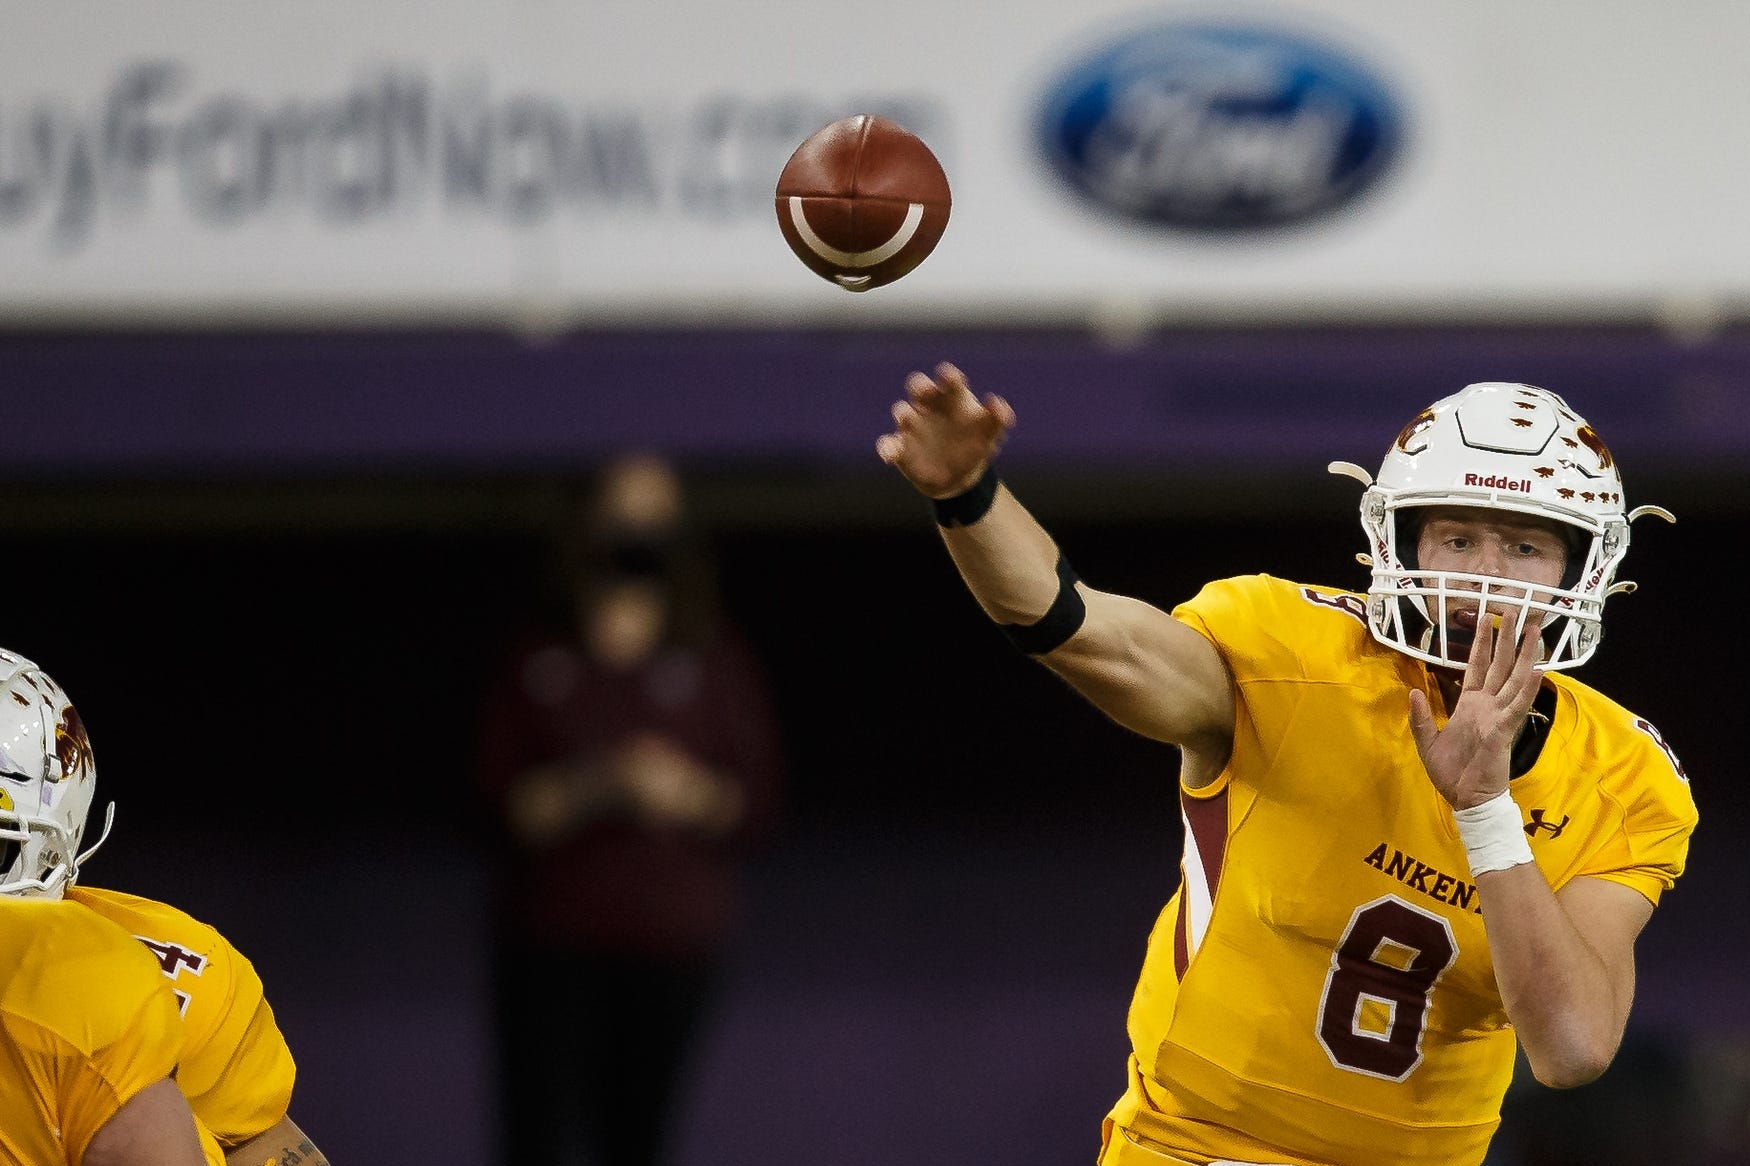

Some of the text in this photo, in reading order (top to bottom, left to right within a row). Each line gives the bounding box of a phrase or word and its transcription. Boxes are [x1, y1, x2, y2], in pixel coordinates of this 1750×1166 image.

[1464, 472, 1532, 494] Riddell
[1363, 842, 1483, 915] ANKEN
[1314, 893, 1460, 1084] 8
